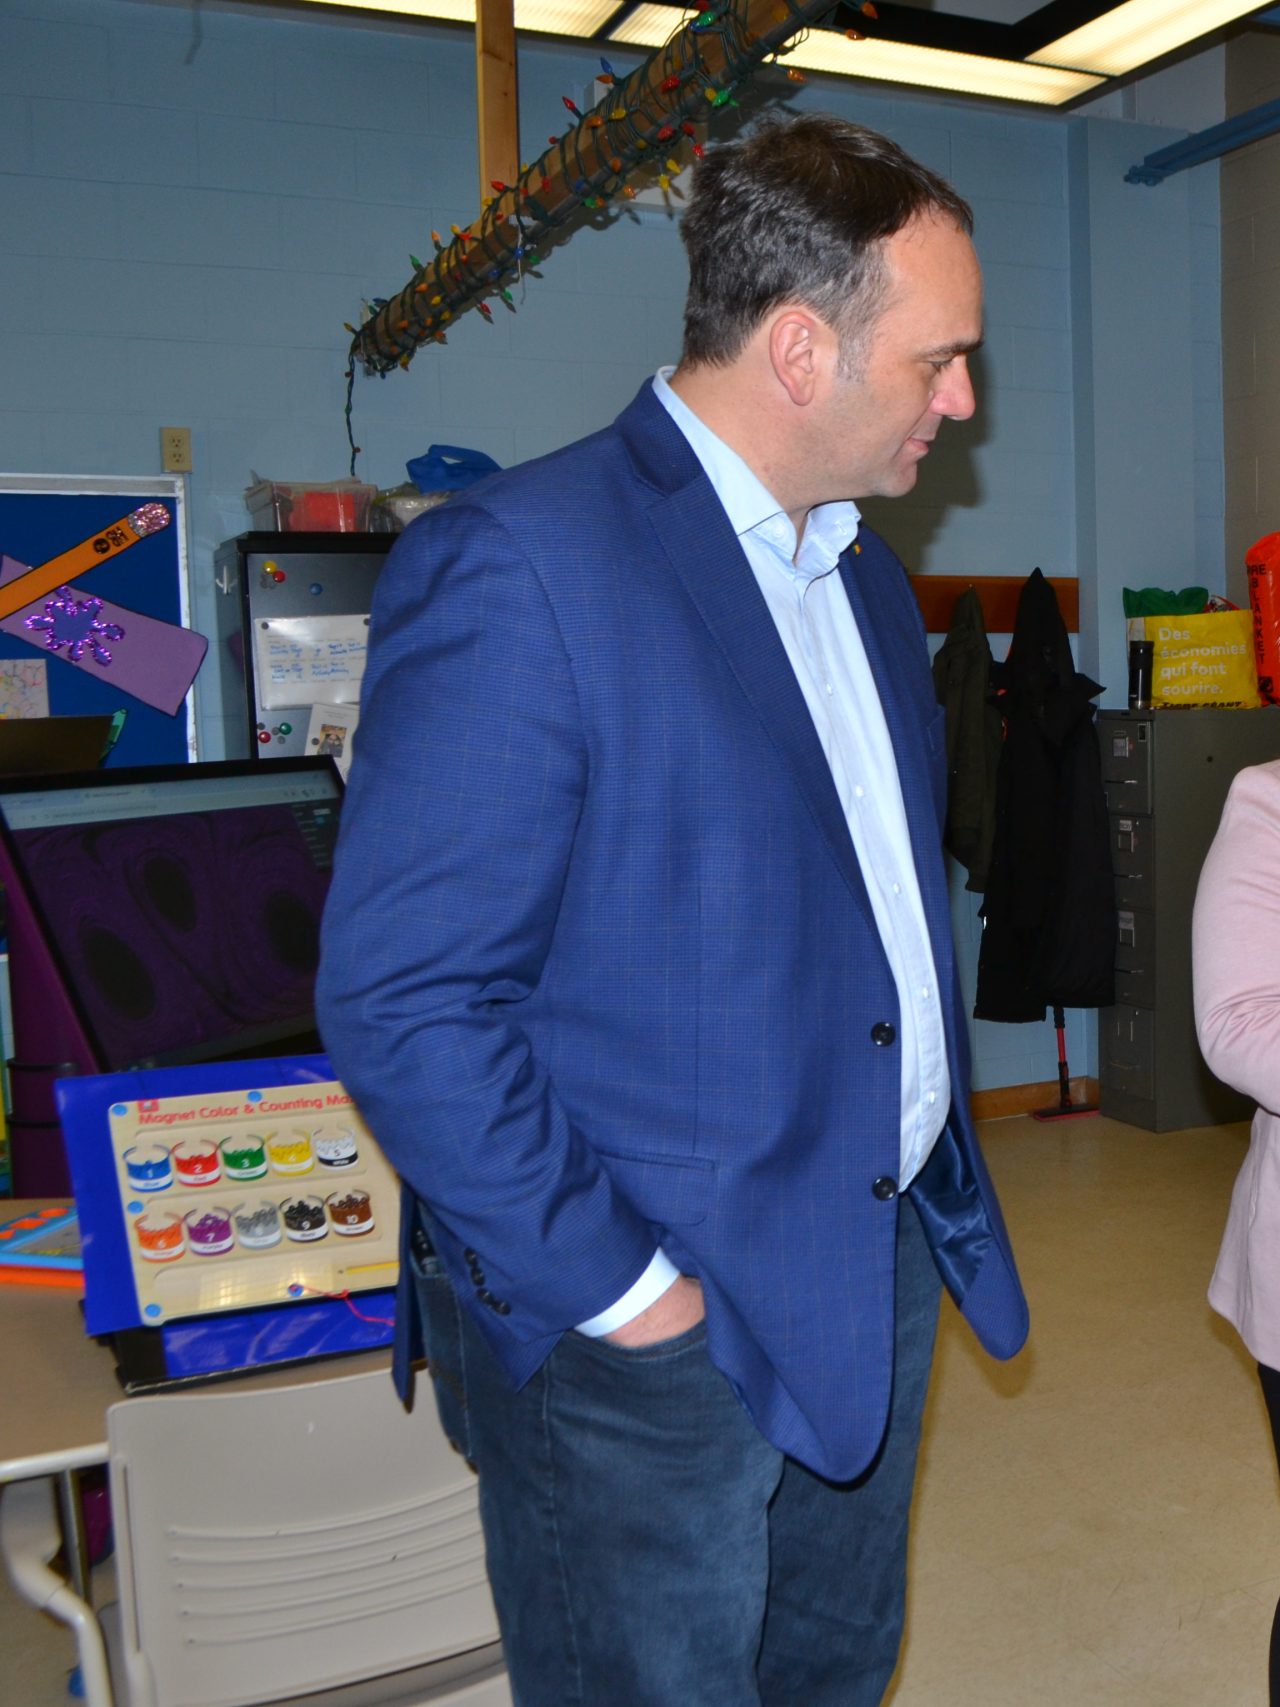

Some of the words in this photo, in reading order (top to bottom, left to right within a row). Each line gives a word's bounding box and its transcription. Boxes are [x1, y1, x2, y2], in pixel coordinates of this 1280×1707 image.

[1159, 627, 1190, 641] Des
[1161, 642, 1247, 658] économies
[1161, 661, 1187, 680] qui
[1191, 661, 1227, 676] font
[1162, 681, 1223, 696] sourire.
[139, 1110, 195, 1125] Magnet
[200, 1103, 239, 1119] Color
[244, 1102, 255, 1114] &
[259, 1094, 323, 1114] Counting
[334, 1148, 341, 1158] 5
[241, 1158, 250, 1168] 3
[194, 1164, 202, 1174] 2
[346, 1215, 359, 1225] 10
[301, 1221, 311, 1231] 9
[206, 1232, 216, 1243] 7
[157, 1239, 166, 1249] 6
